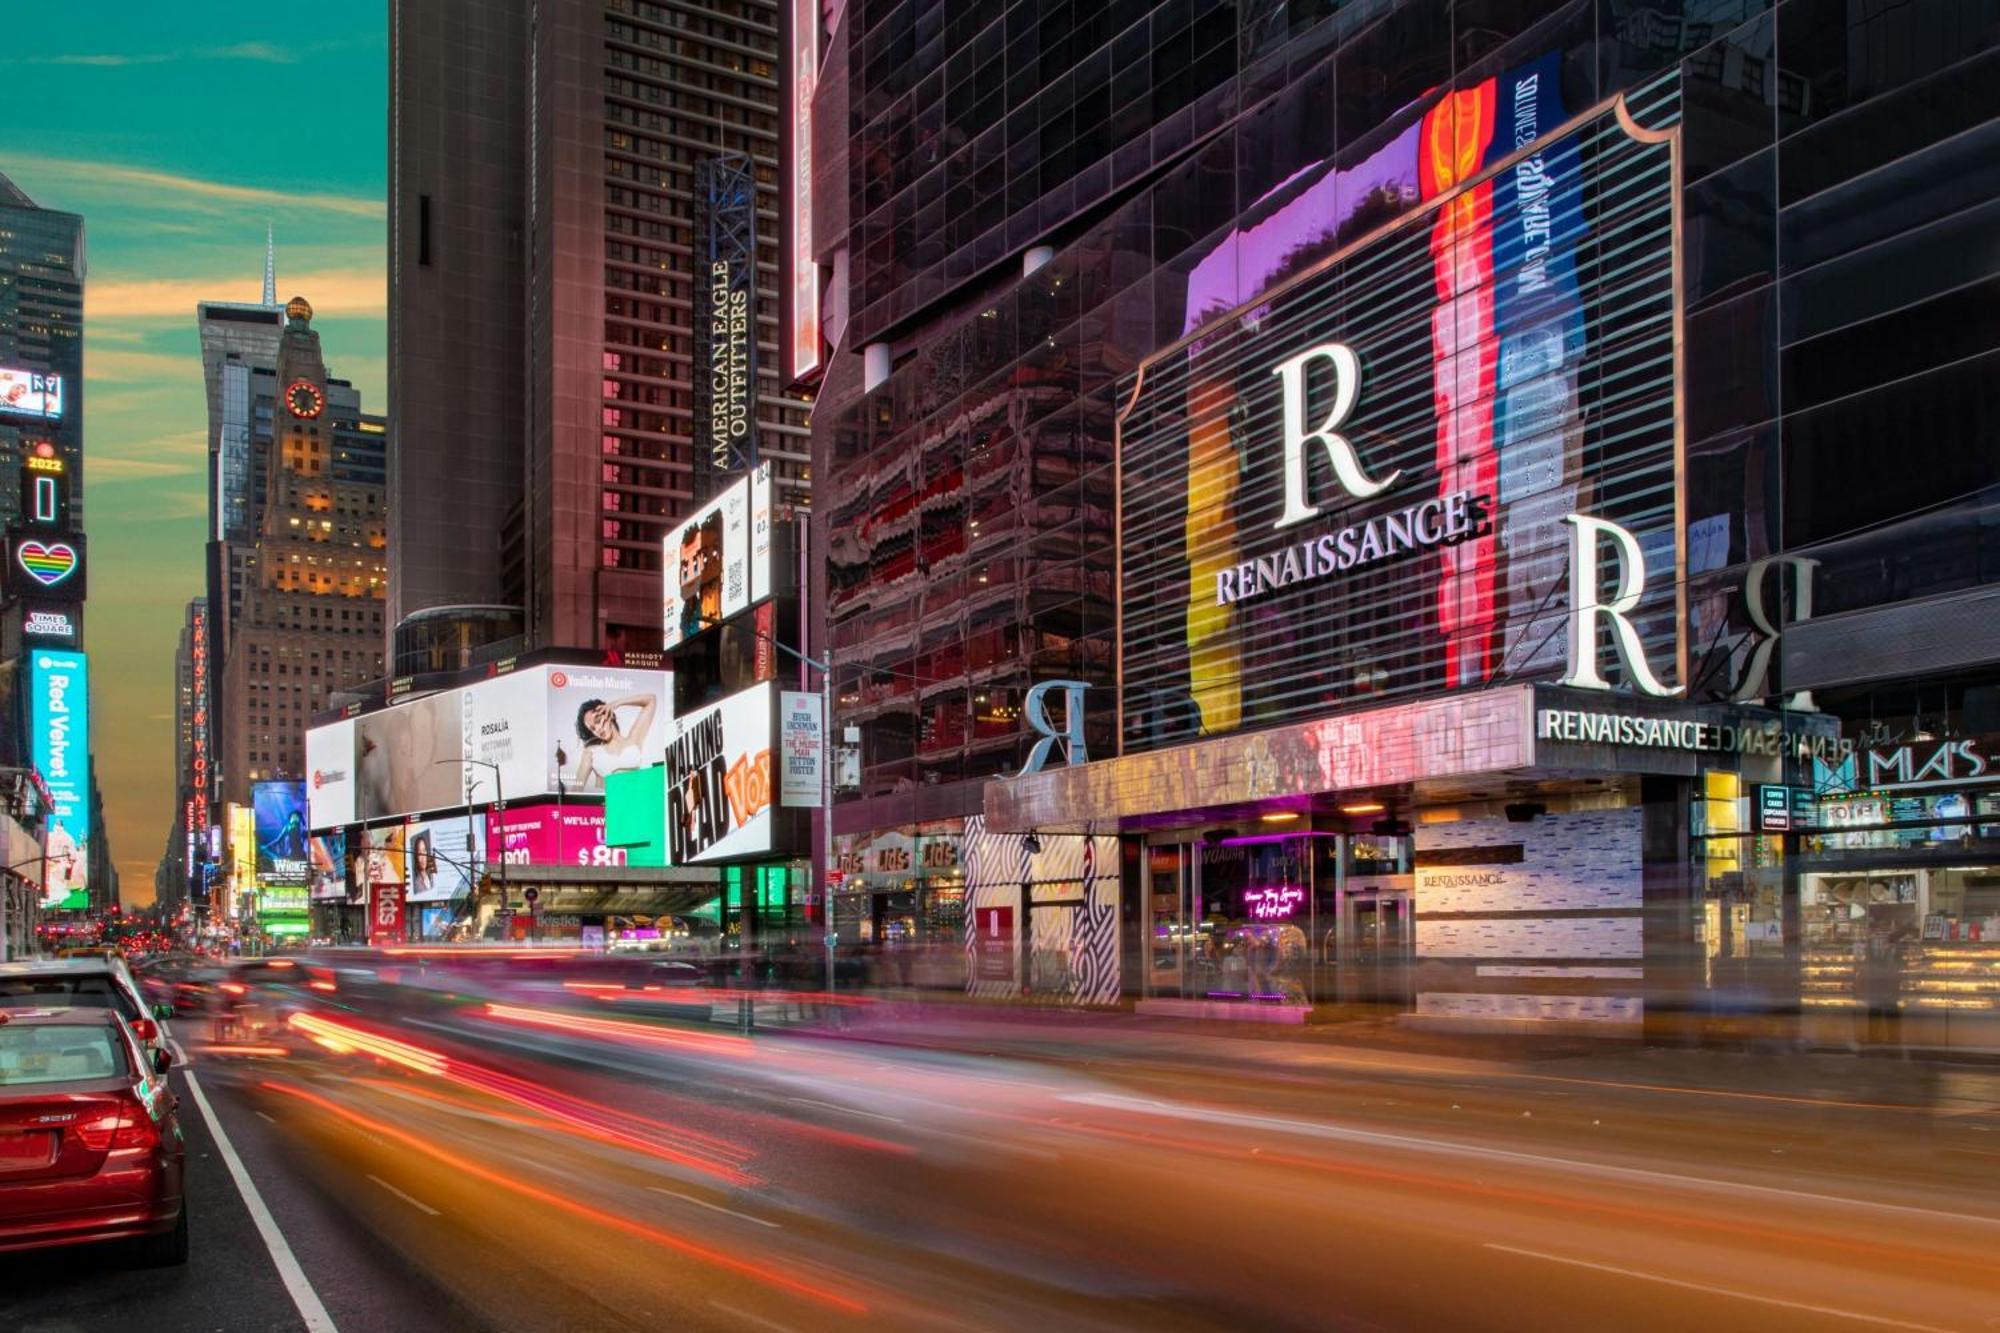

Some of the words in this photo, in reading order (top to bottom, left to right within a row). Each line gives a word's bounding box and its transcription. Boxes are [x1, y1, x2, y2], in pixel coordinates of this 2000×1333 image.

[713, 259, 729, 334] EAGLE
[730, 291, 747, 437] OUTFITTERS
[713, 344, 729, 470] AMERICAN
[1272, 343, 1402, 529] R
[28, 456, 63, 472] 2022
[1216, 490, 1473, 607] RENAISSANCE
[25, 622, 73, 635] SQUARE
[30, 612, 67, 624] TIMES
[1557, 514, 1686, 697] R
[624, 652, 664, 661] MARRIOTT
[624, 659, 660, 668] MARQUIS
[48, 674, 69, 713] Red
[48, 715, 70, 778] Velvet
[665, 707, 723, 789] WALKING
[1539, 709, 1709, 750] RENAISSANCE
[668, 754, 731, 863] DEAD
[379, 886, 399, 926] tkts
[1423, 873, 1504, 888] RENAISSANCE
